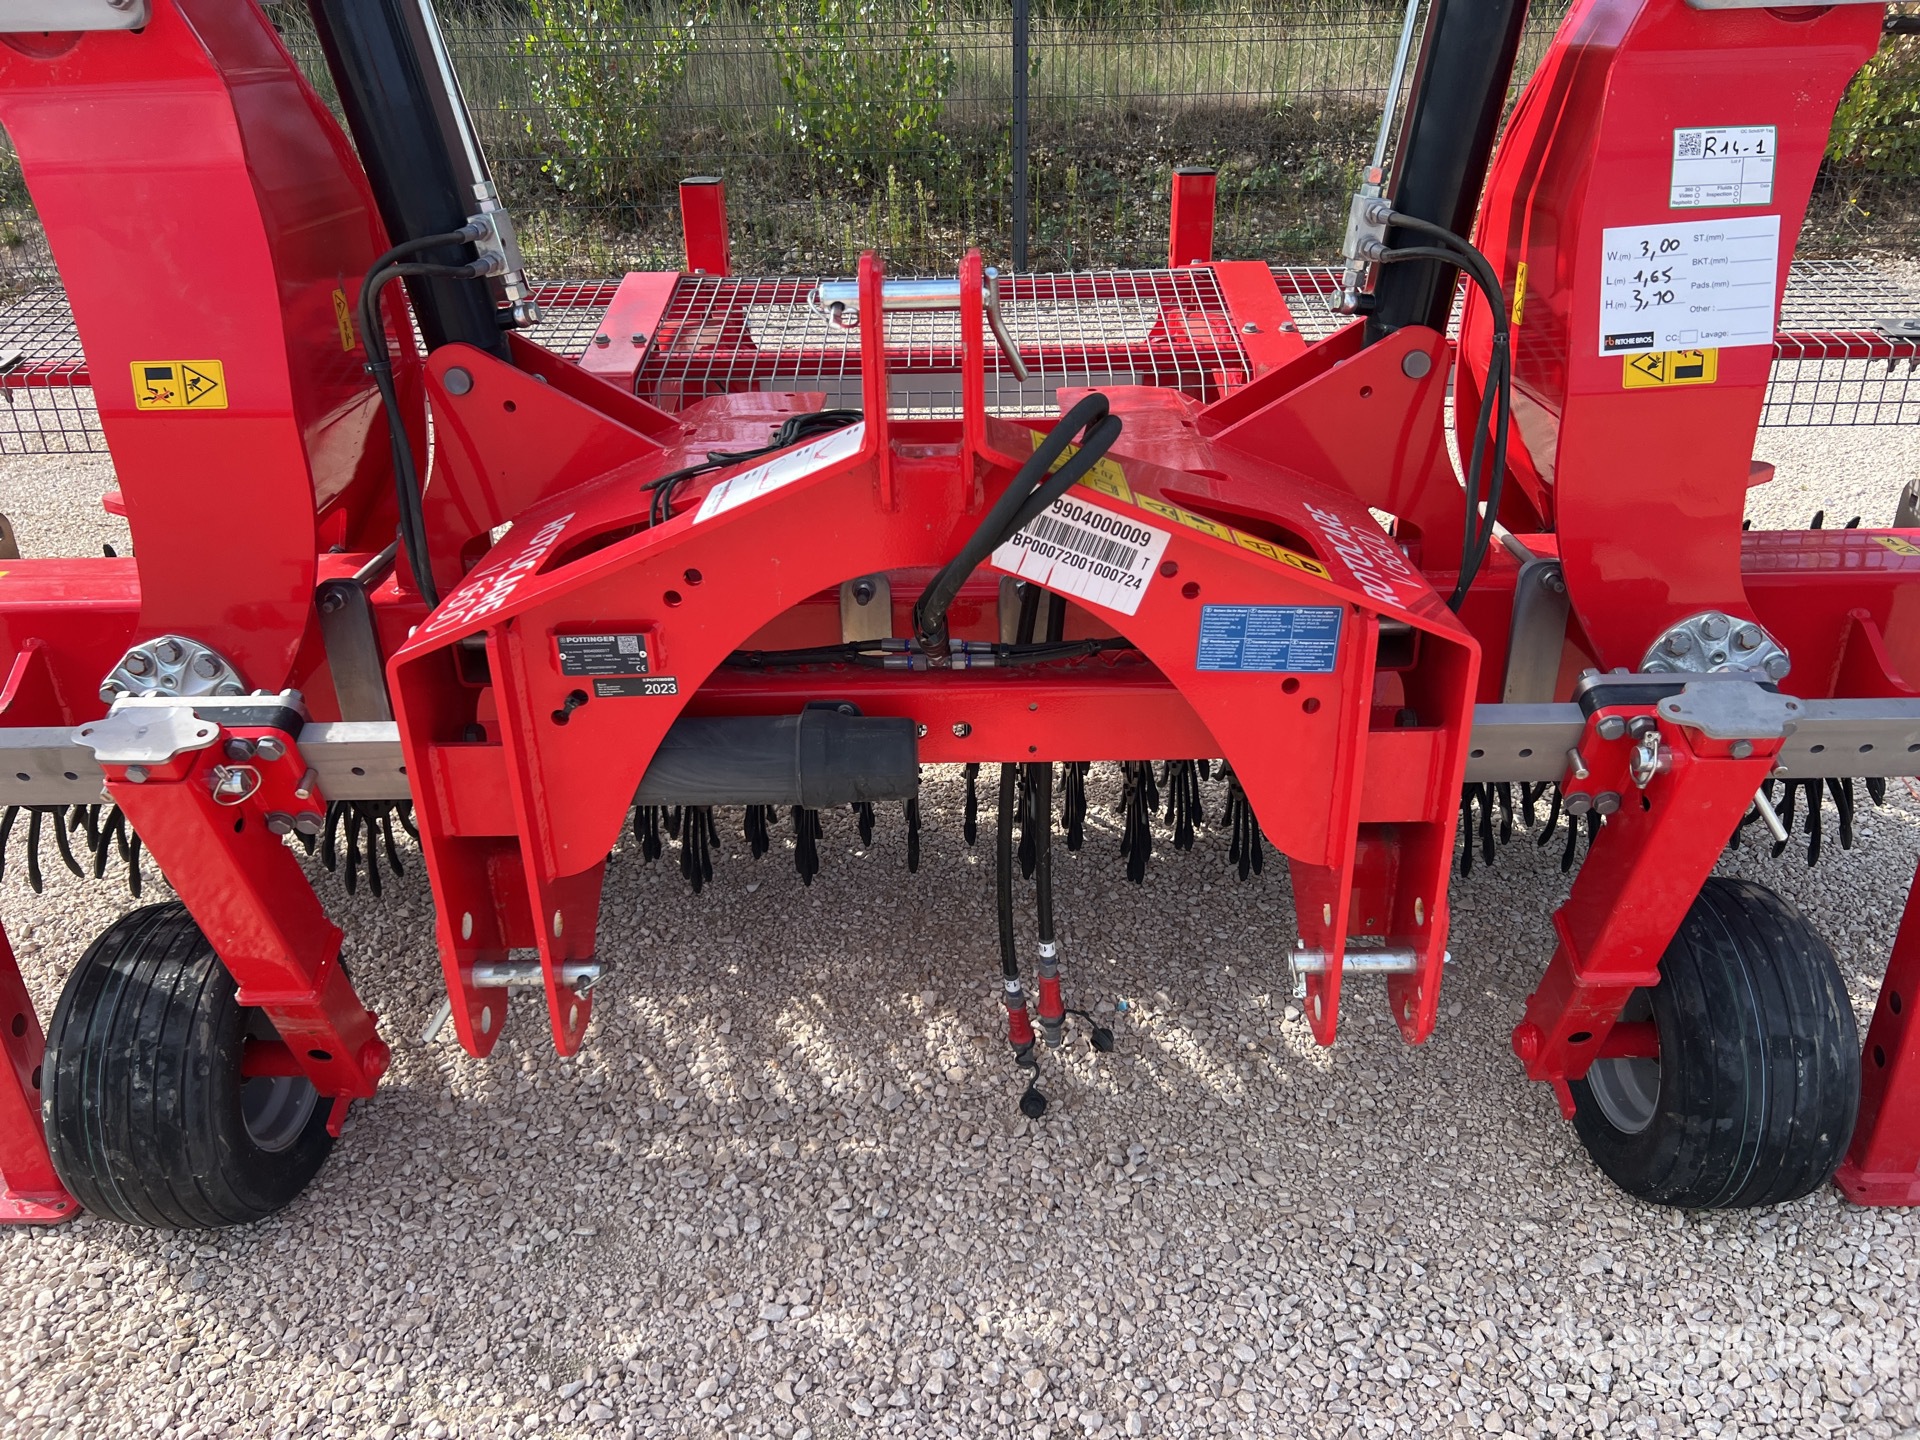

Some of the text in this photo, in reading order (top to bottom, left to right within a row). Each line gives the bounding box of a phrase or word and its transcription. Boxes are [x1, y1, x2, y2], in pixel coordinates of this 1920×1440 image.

[461, 512, 577, 623] ROTOCARE
[1007, 532, 1143, 591] BP00072001000724
[1302, 502, 1407, 610] ROTOCARE
[644, 683, 677, 695] 2023
